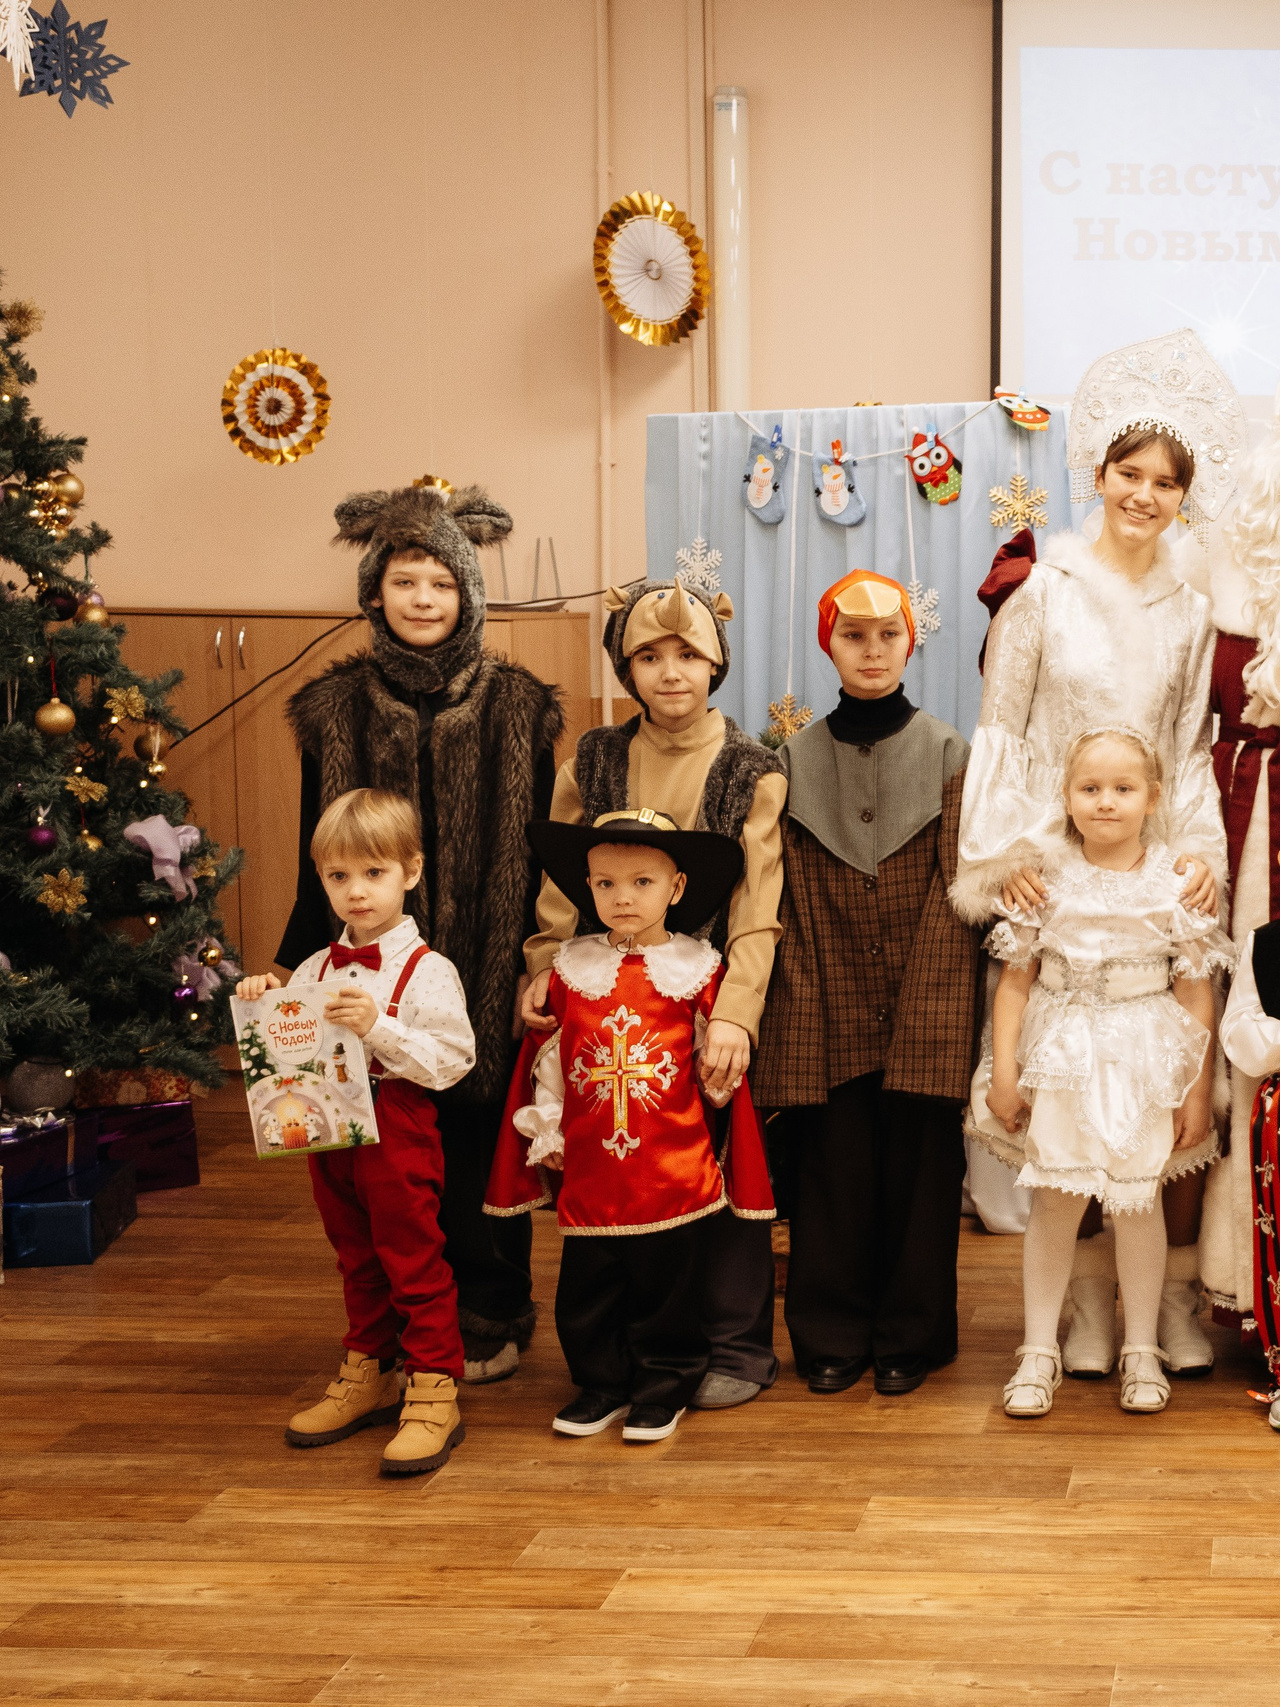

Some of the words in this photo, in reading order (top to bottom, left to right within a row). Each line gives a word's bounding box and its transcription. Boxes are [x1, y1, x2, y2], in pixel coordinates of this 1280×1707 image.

[1039, 150, 1082, 196] С
[268, 1023, 277, 1035] С
[278, 1019, 318, 1034] Новым
